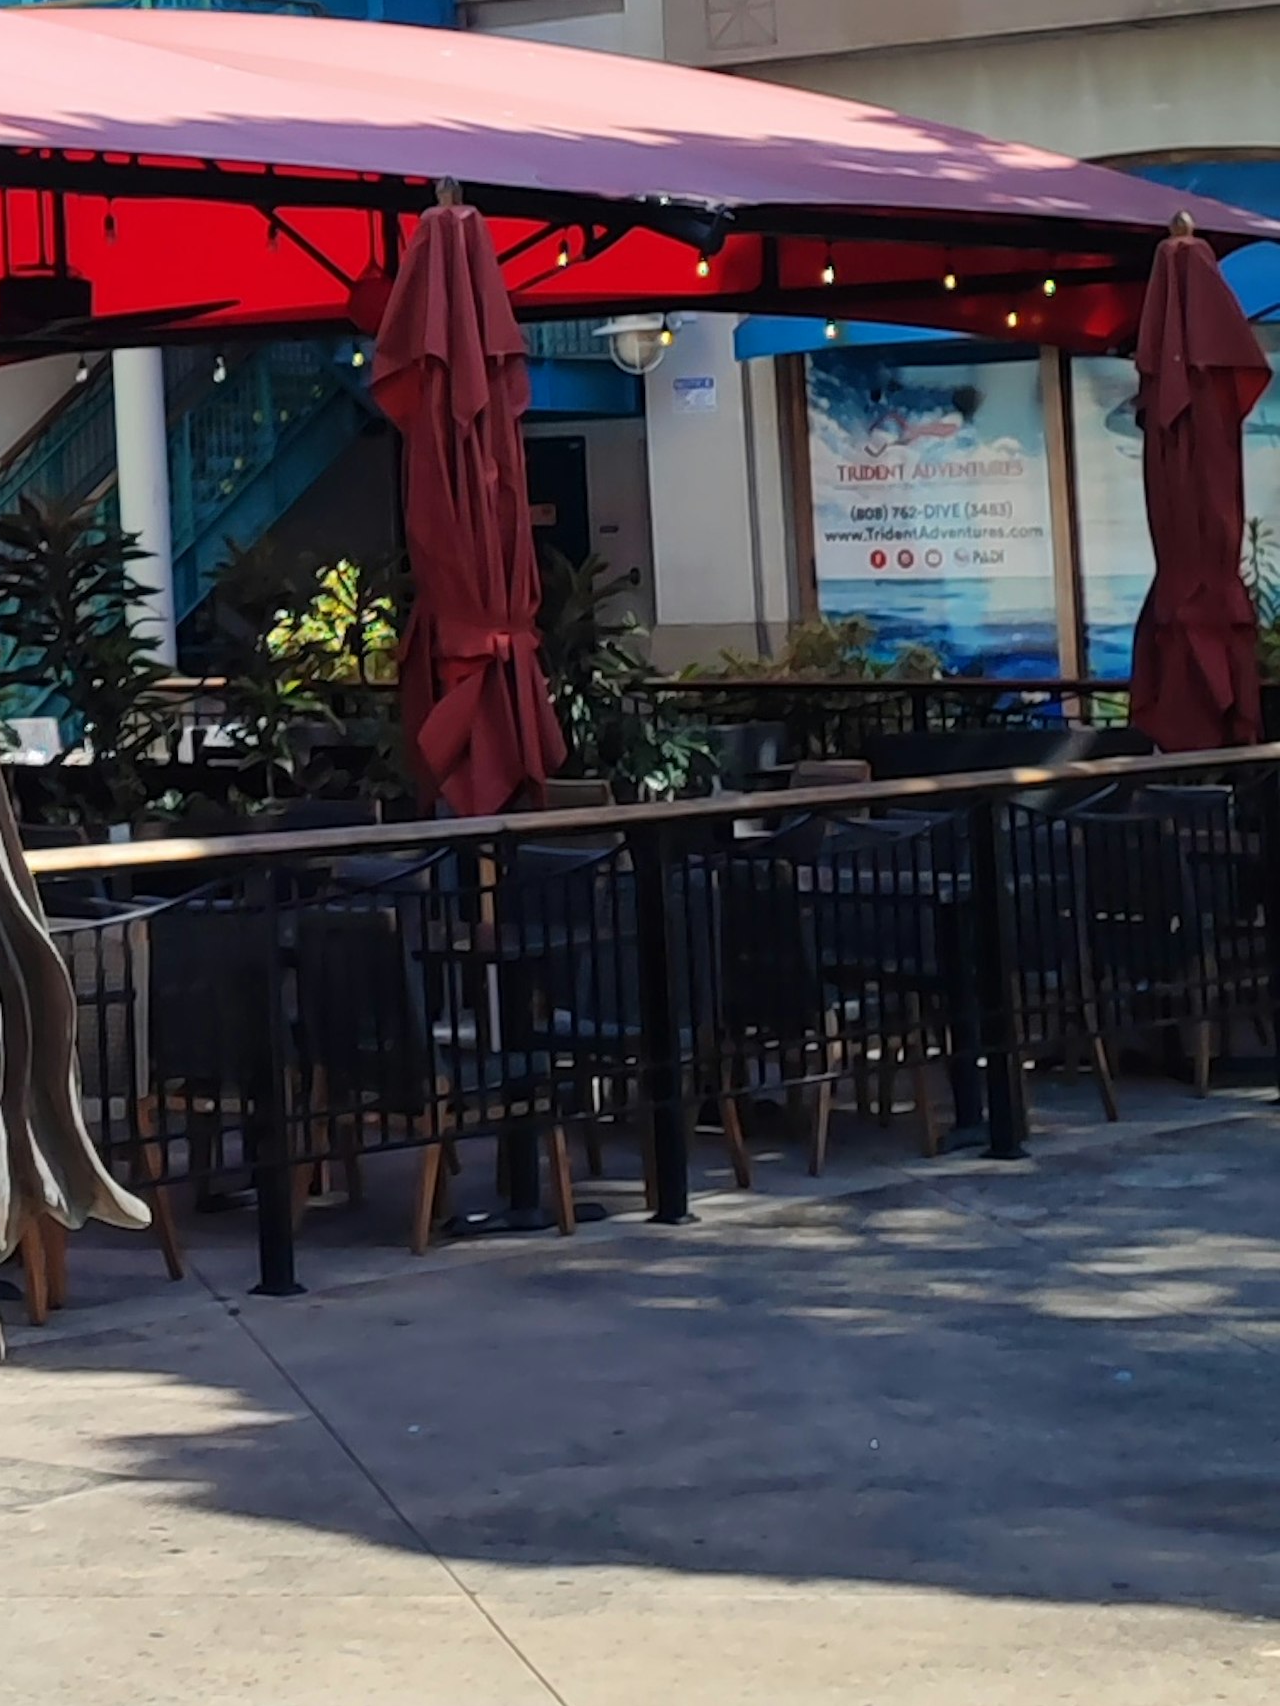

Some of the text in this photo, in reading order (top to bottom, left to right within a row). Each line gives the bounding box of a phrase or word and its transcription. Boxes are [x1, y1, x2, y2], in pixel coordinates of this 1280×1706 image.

[837, 459, 1023, 482] TRIDENT ADVENTURES
[850, 504, 888, 522] (808)
[825, 524, 1044, 542] www.TridentAdventures.com
